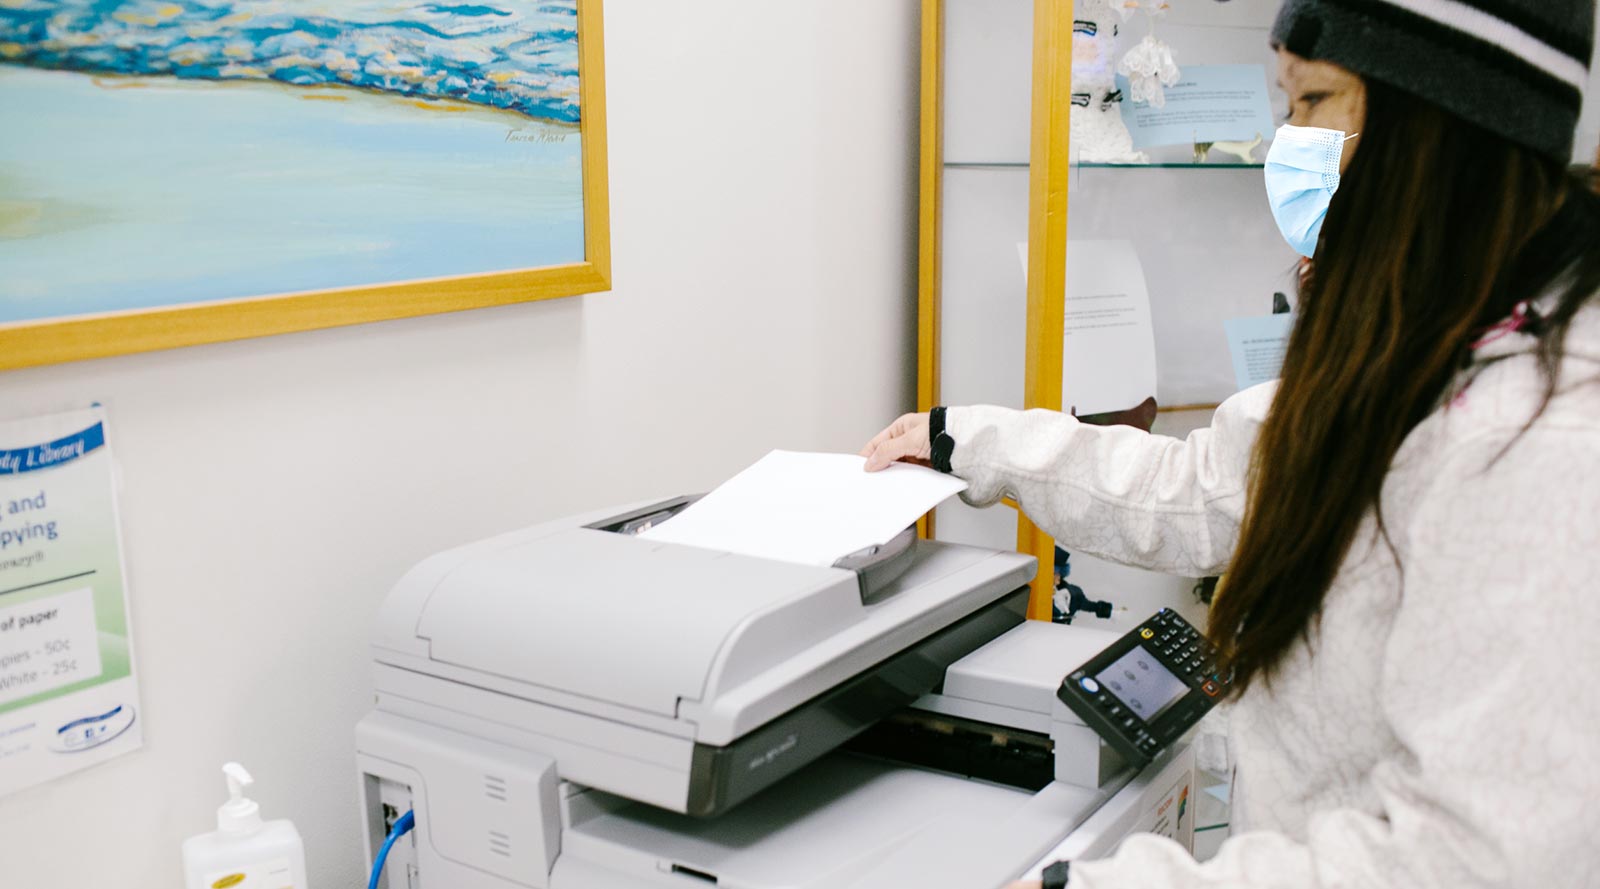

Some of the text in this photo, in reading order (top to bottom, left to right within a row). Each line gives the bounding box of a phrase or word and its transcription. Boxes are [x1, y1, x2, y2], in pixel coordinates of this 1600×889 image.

[26, 439, 84, 467] Library
[8, 489, 46, 514] and
[0, 608, 58, 631] of paper
